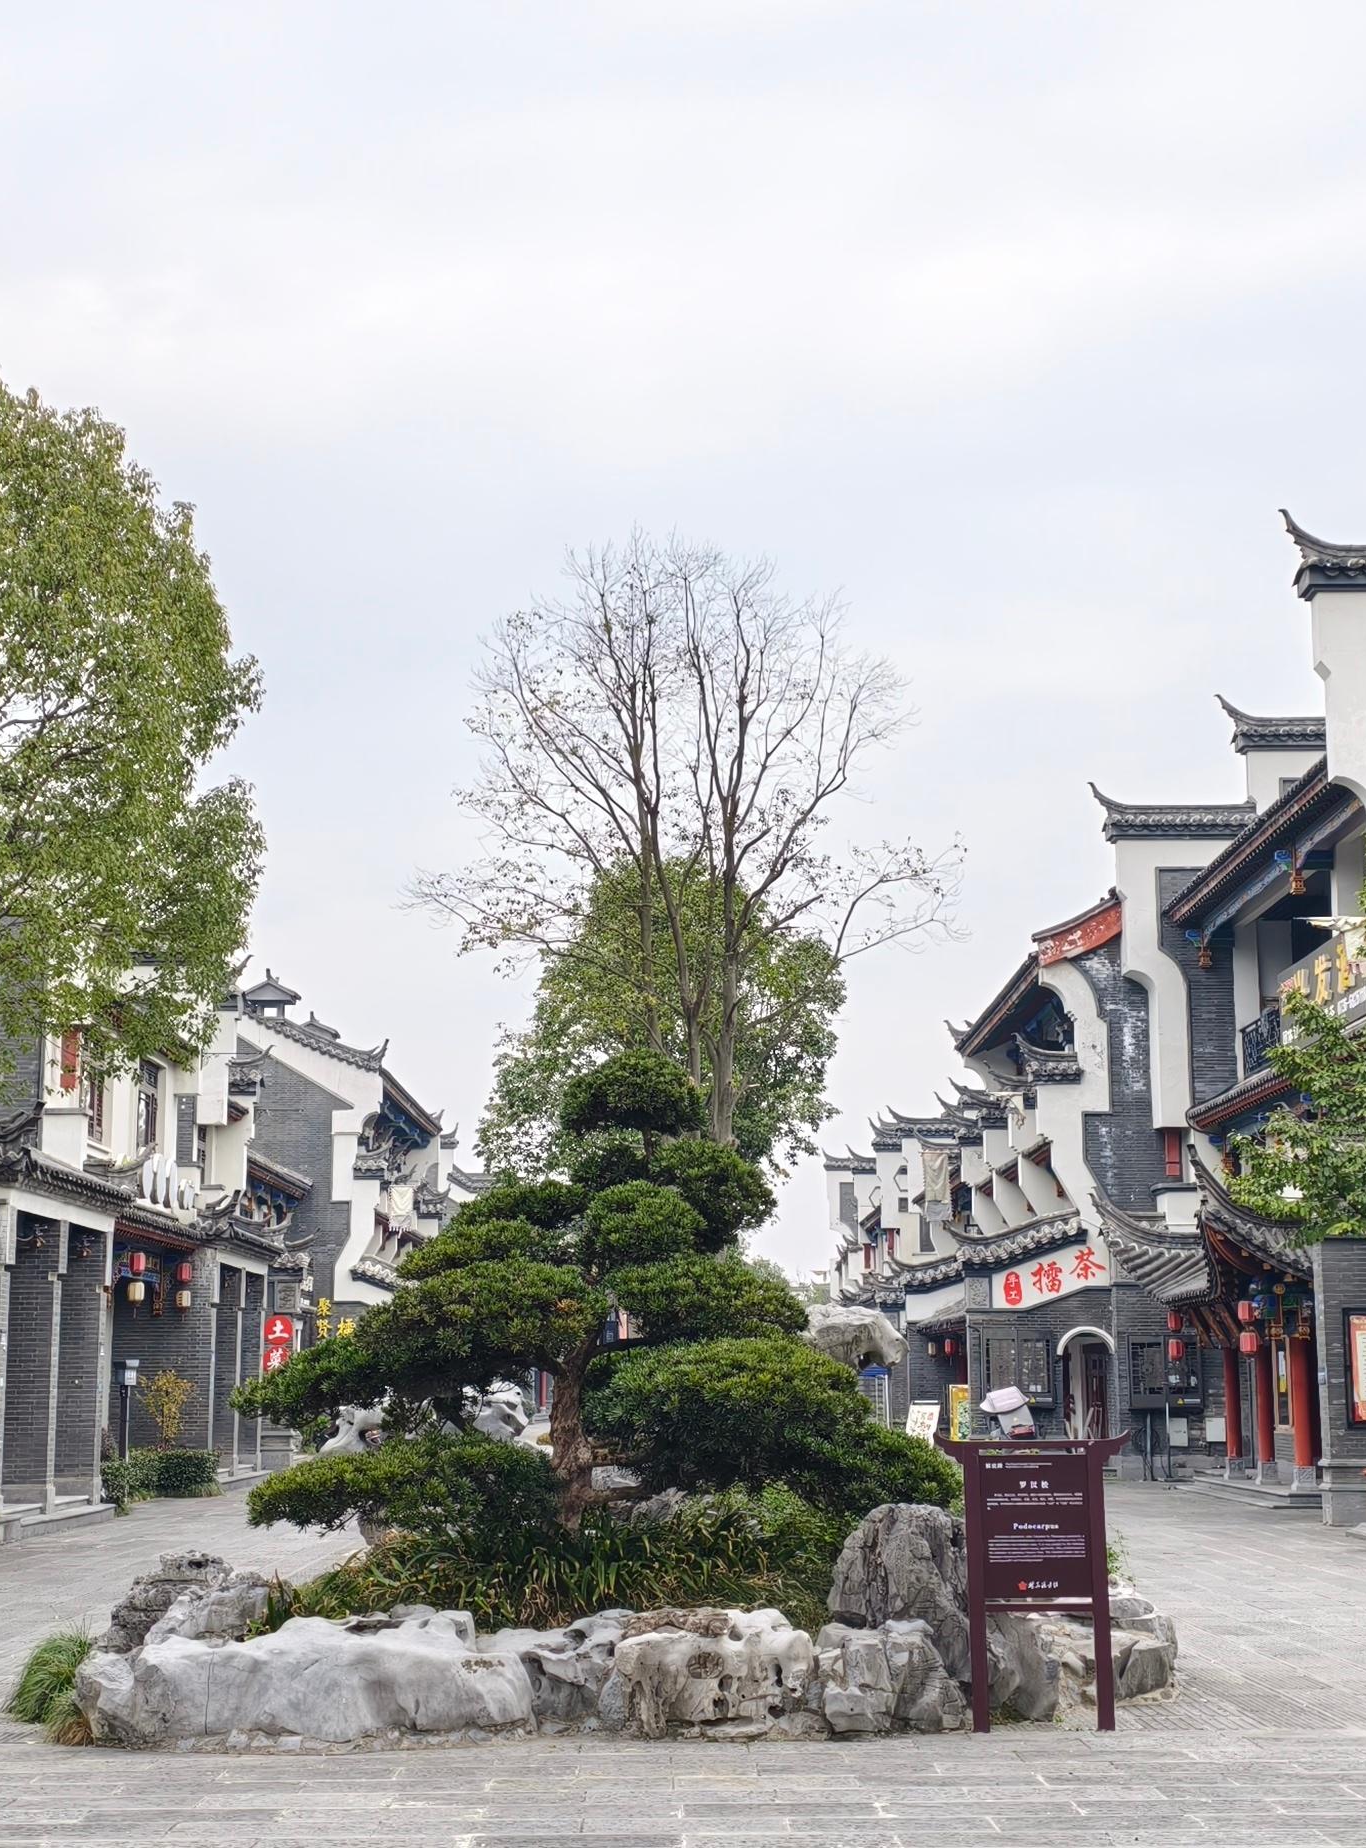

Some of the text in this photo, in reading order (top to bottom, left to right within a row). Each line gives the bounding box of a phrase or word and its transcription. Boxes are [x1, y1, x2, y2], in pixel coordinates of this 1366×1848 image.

[1006, 1274, 1020, 1300] 手工
[1030, 1246, 1107, 1294] 擂茶
[266, 1319, 290, 1370] 土菜
[1013, 1522, 1060, 1531] Podocarpus
